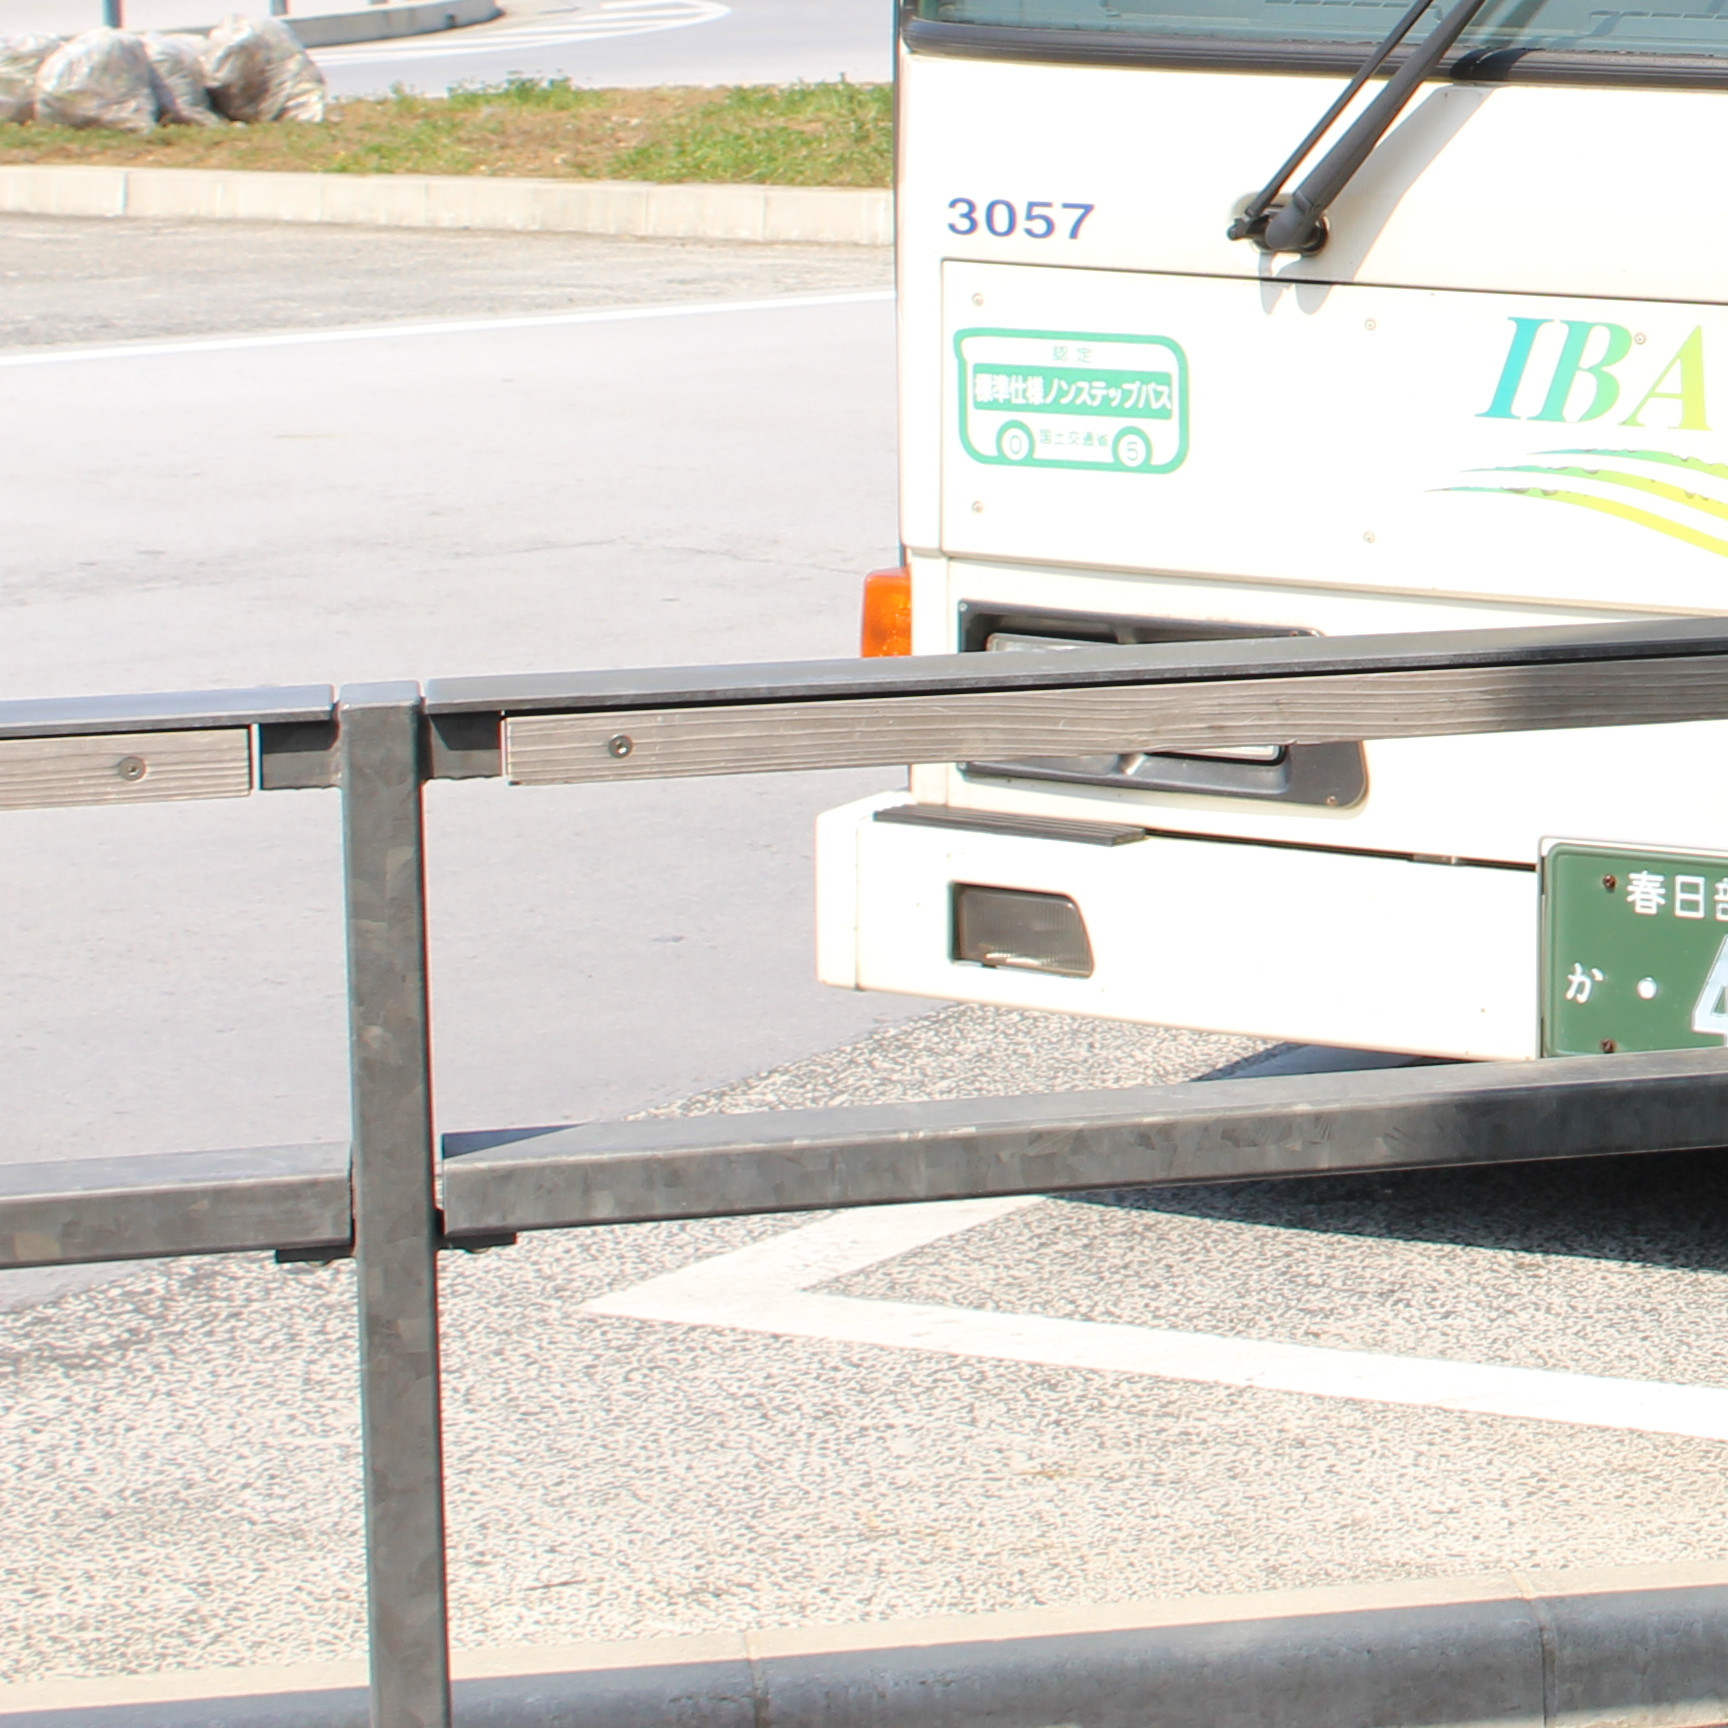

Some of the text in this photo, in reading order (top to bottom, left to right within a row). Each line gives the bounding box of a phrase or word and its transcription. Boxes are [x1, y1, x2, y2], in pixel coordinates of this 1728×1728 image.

[946, 197, 1095, 240] 3057
[1053, 345, 1092, 363] 認定
[1475, 316, 1712, 432] IBA
[975, 373, 1172, 410] 標準仕様ノンステップバス
[1564, 962, 1604, 1004] か
